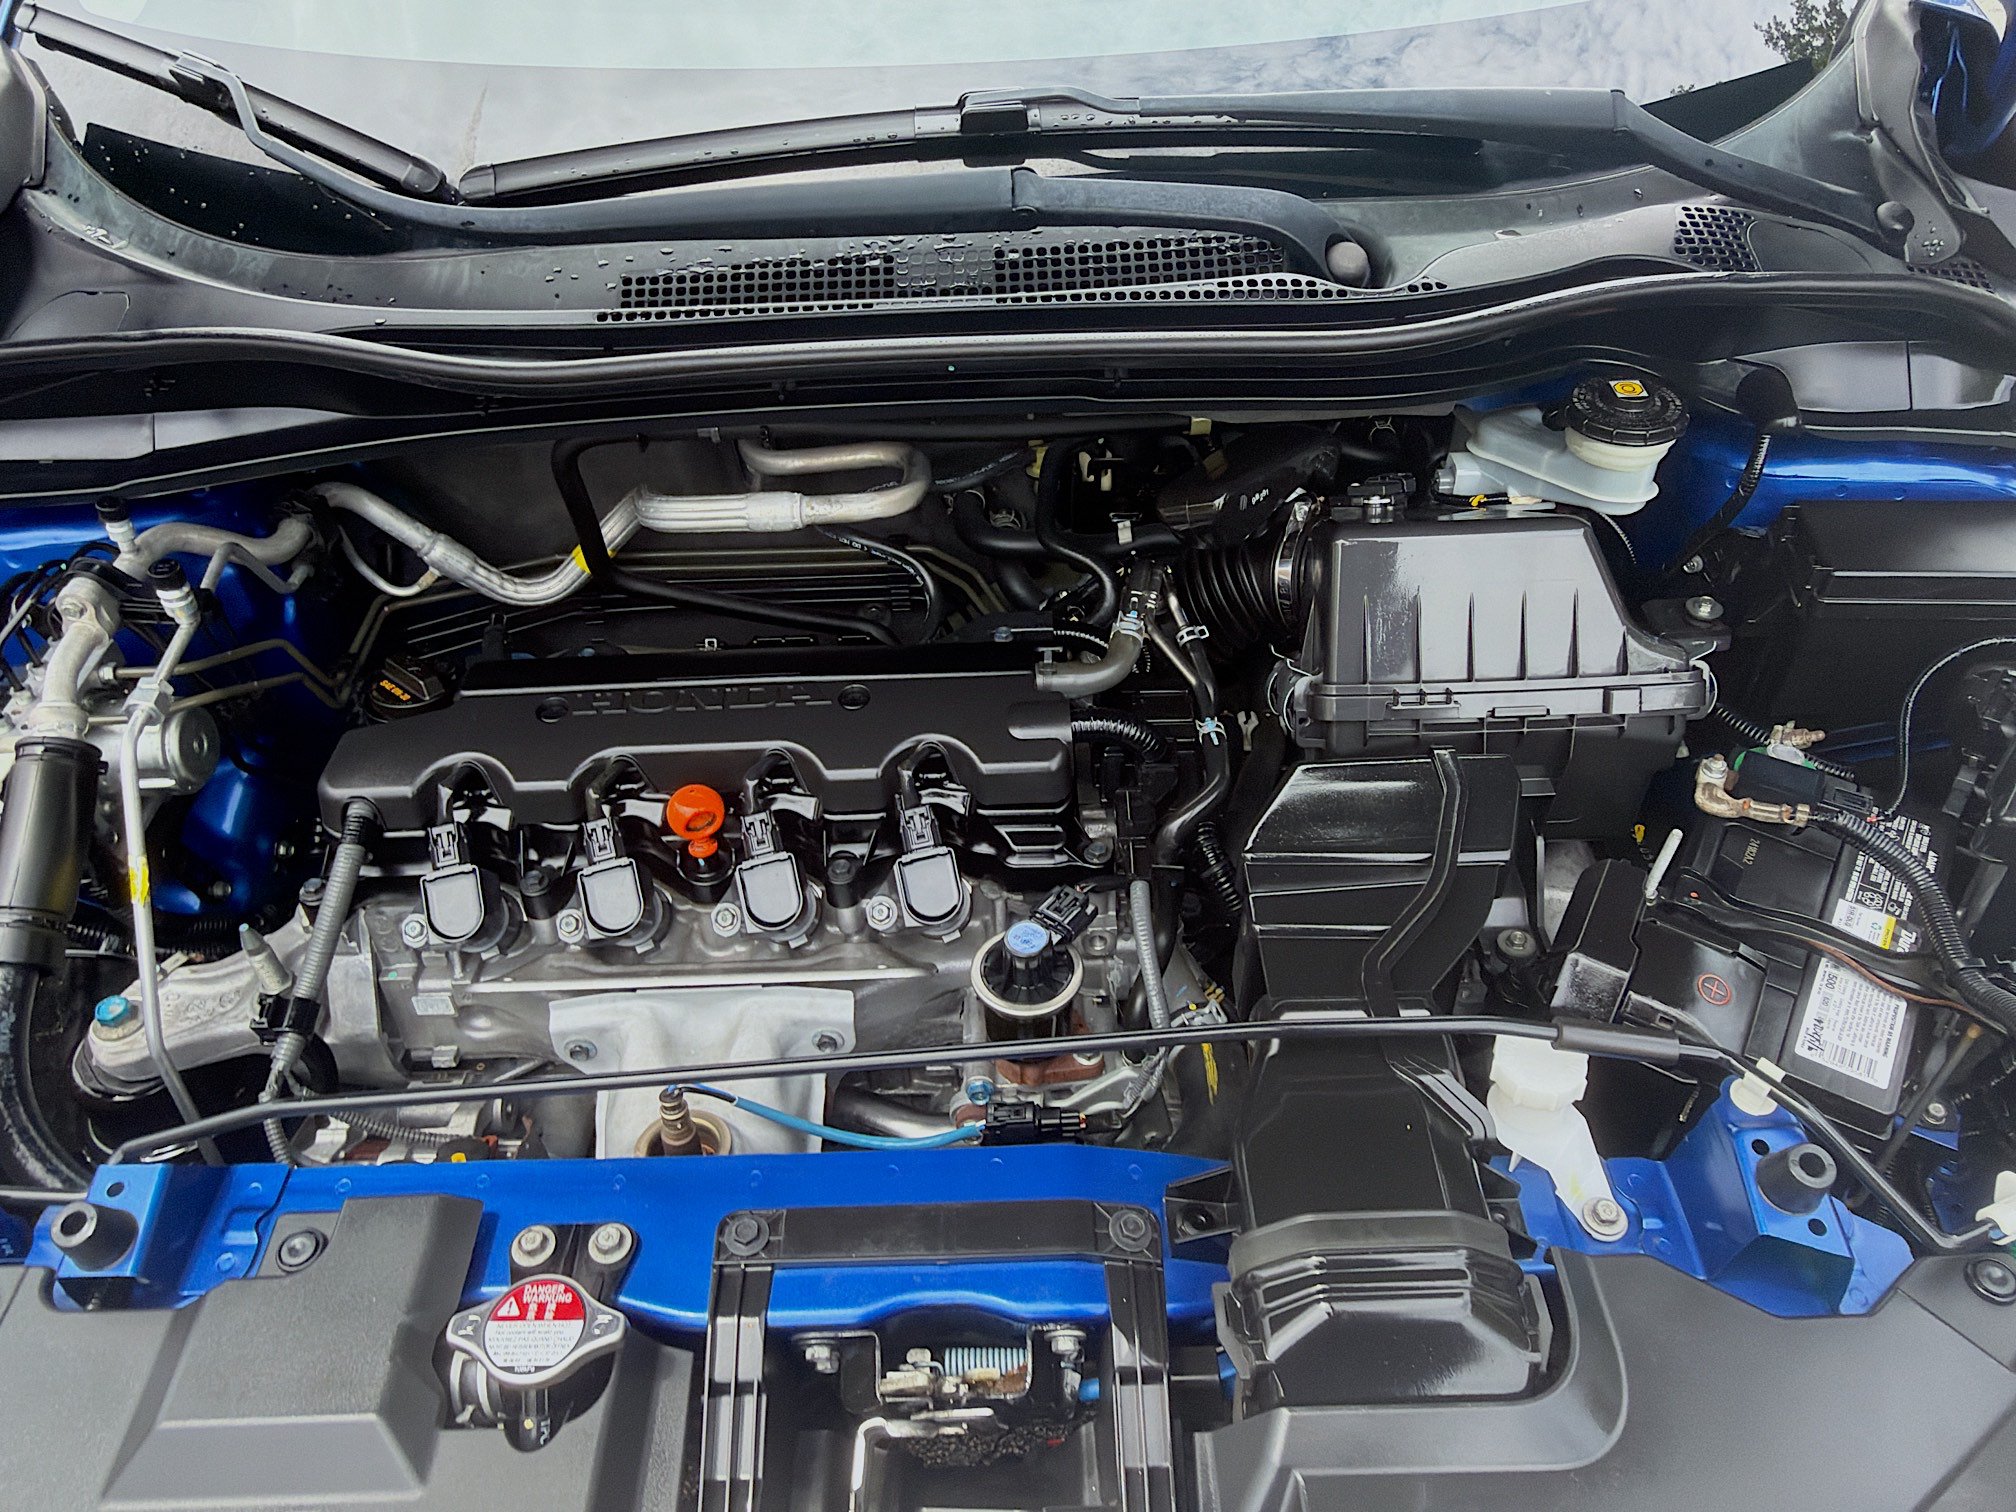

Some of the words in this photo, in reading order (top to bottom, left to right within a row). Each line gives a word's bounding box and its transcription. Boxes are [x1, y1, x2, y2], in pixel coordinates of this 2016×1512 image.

[572, 684, 832, 715] HONDA
[1825, 973, 1838, 990] 500
[524, 1284, 566, 1293] DANGER
[522, 1291, 572, 1303] WARNUNG
